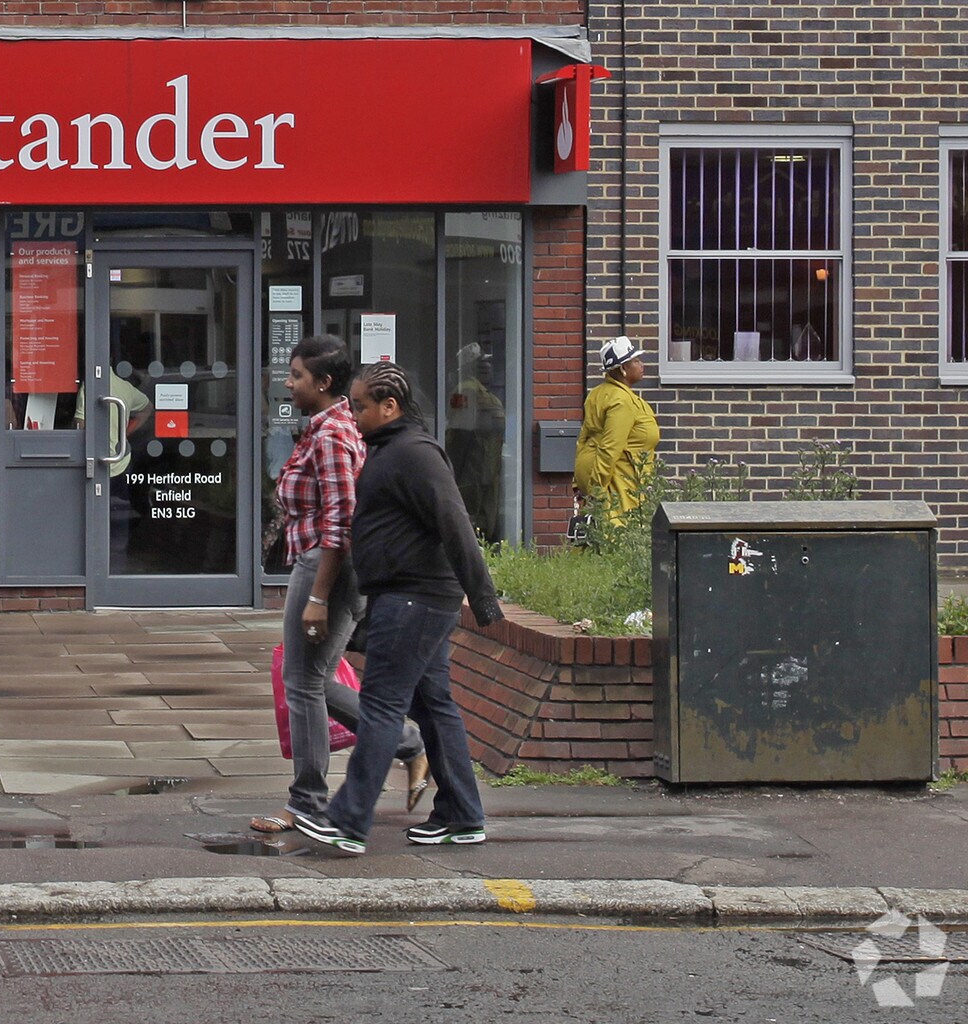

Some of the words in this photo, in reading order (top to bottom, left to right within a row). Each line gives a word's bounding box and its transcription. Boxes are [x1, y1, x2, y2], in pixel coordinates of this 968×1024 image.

[18, 247, 35, 256] Our
[36, 247, 71, 257] products
[18, 257, 35, 265] and
[36, 257, 69, 265] services
[125, 473, 144, 484] 199
[148, 473, 192, 484] Hertford
[194, 473, 222, 484] Road
[155, 490, 192, 501] Enfield
[151, 508, 173, 519] EN3
[175, 508, 196, 519] 5LG
